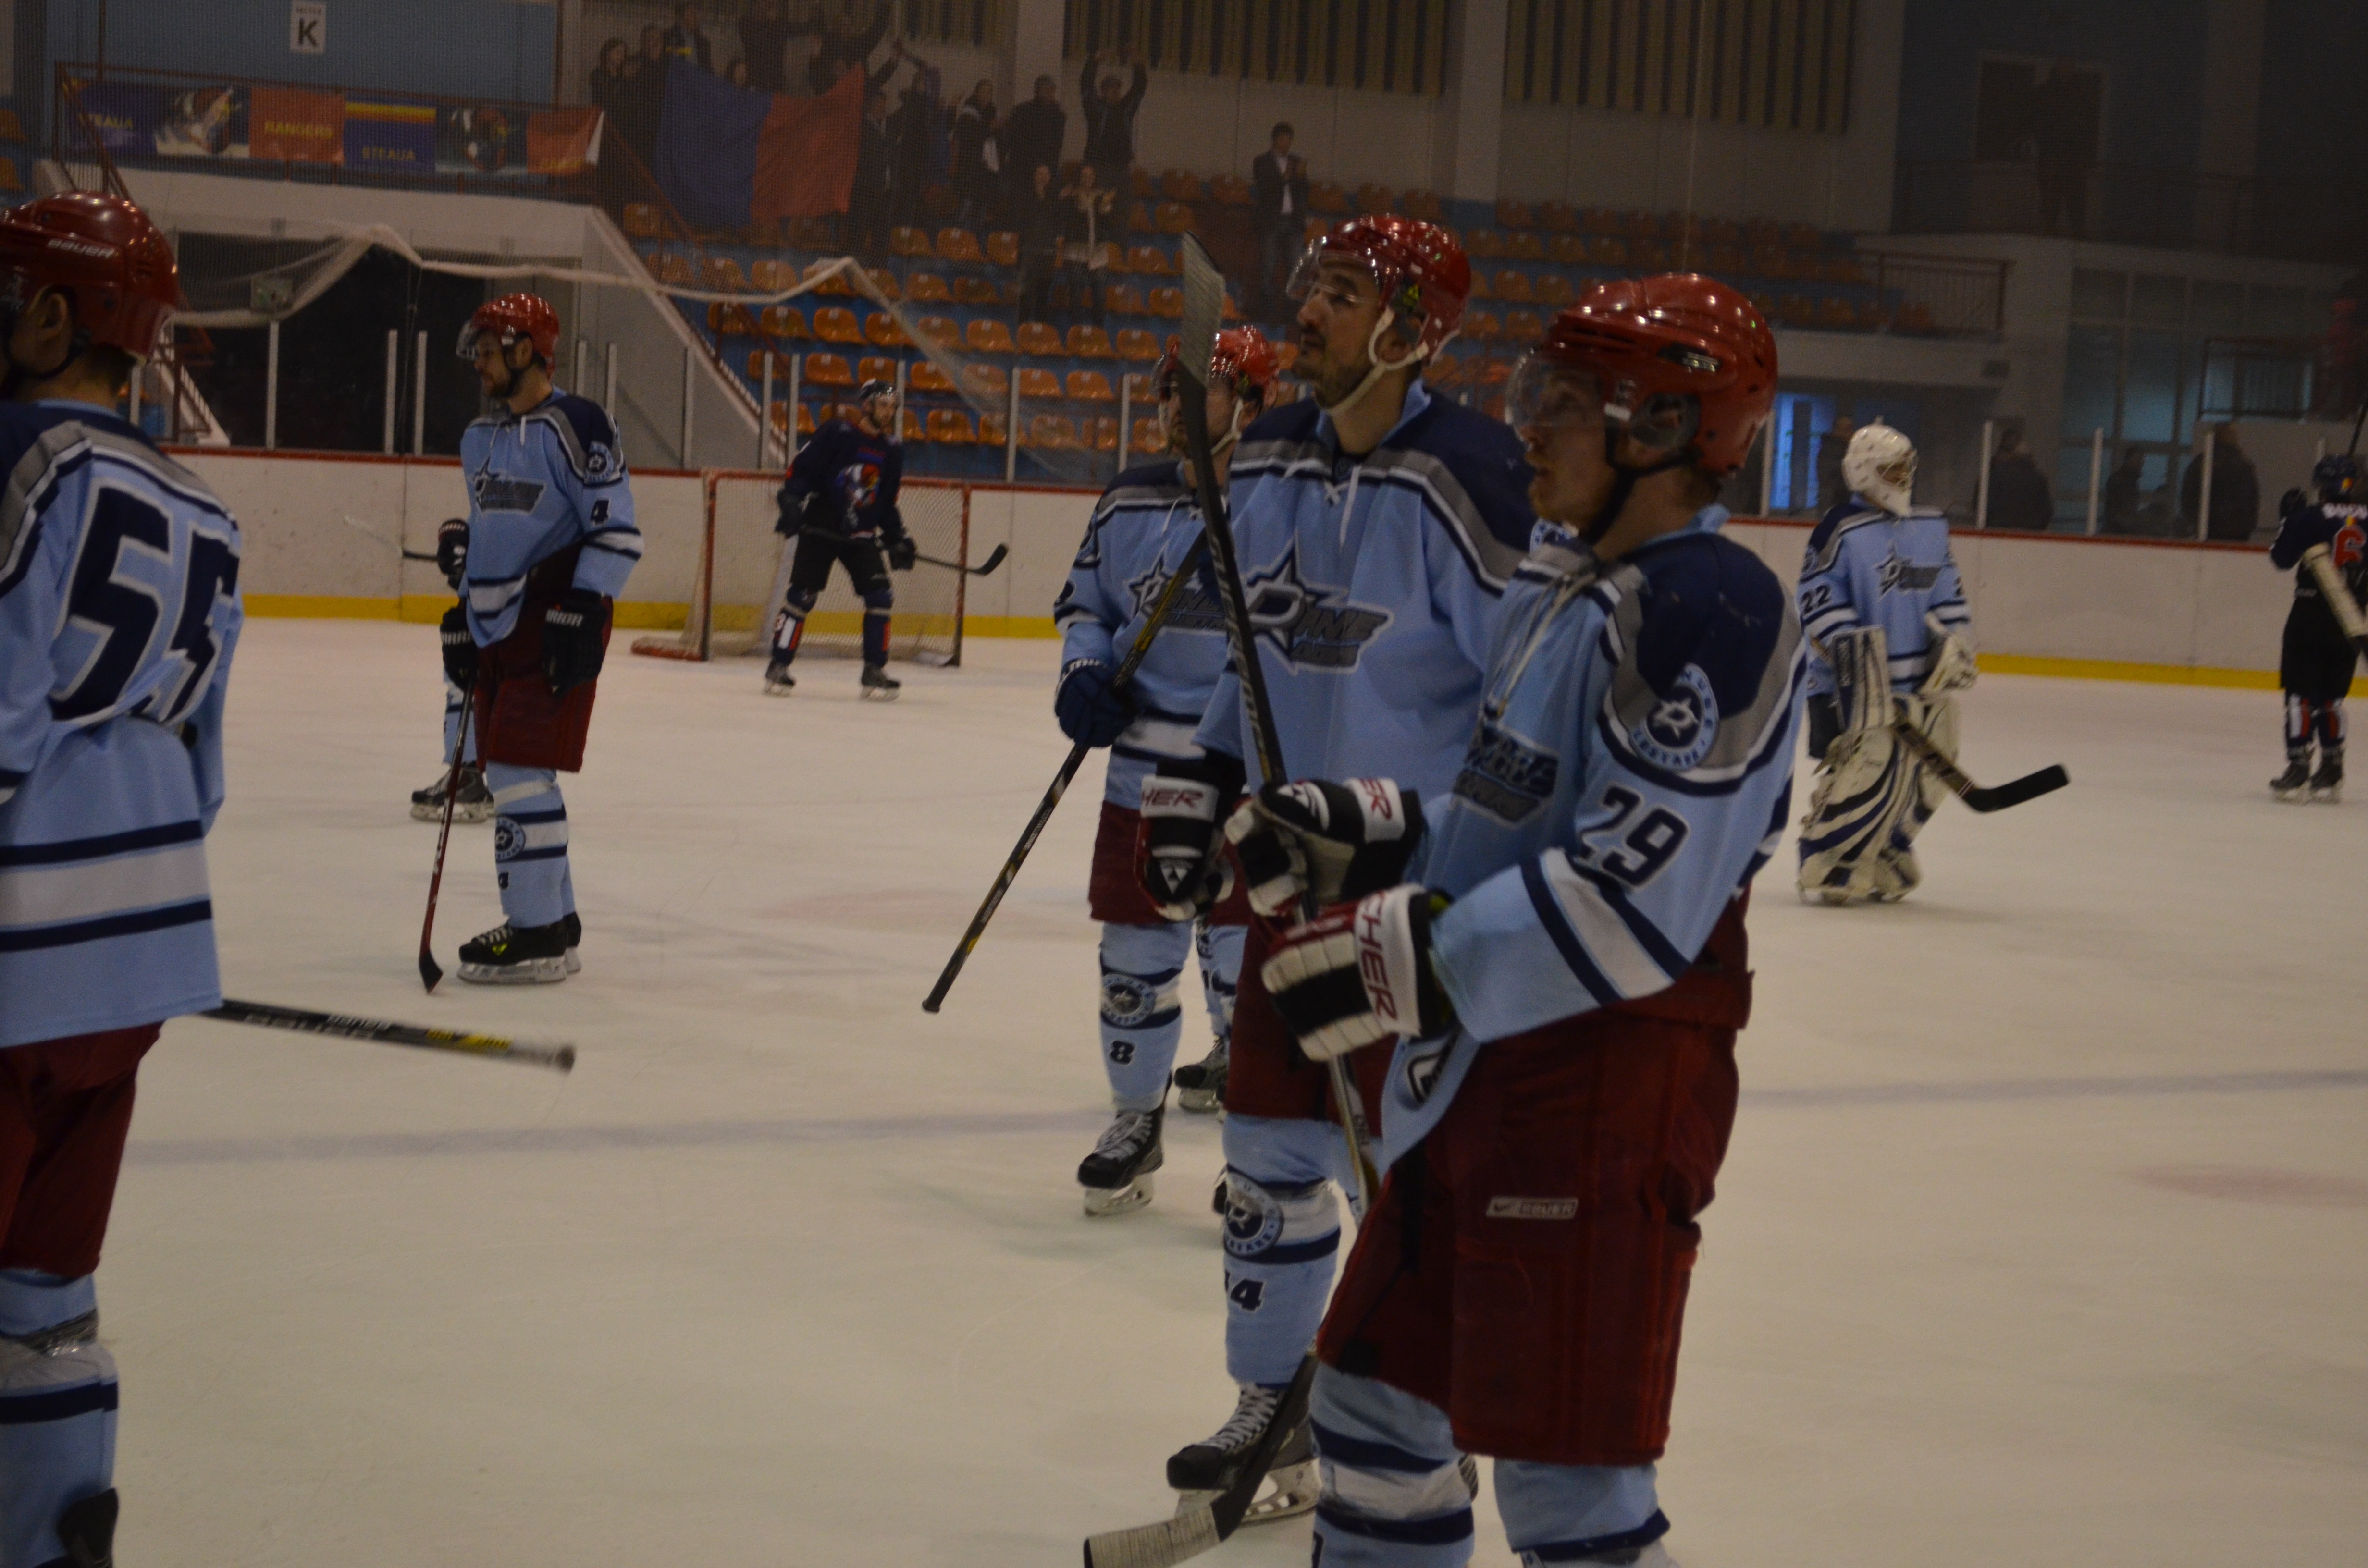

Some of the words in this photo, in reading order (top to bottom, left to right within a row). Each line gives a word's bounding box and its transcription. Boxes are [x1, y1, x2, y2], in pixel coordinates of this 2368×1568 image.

[298, 18, 318, 47] K
[47, 238, 116, 259] BAUER
[1801, 583, 1832, 613] 22
[1110, 1040, 1135, 1066] 8
